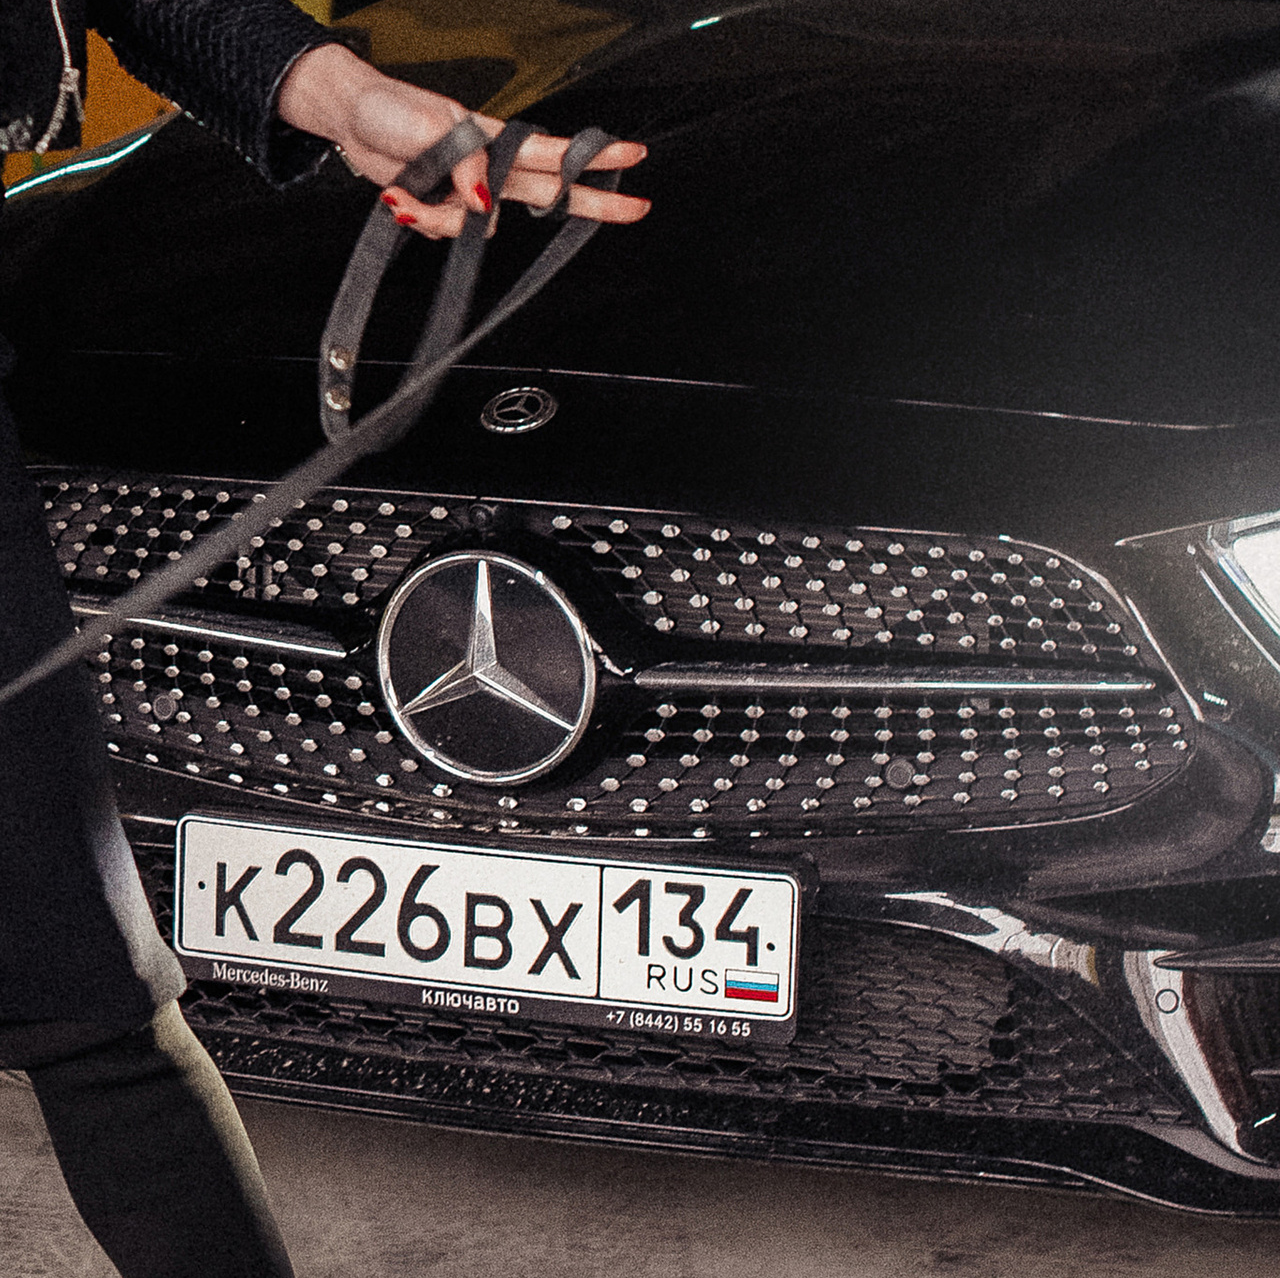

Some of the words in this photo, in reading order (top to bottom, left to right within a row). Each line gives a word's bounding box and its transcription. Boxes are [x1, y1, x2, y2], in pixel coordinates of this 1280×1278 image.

[612, 878, 760, 967] 134
[212, 961, 329, 993] Mercedes-Benz
[646, 963, 719, 995] RUS
[606, 1010, 625, 1025] +7
[629, 1010, 679, 1033] (8442)
[683, 1016, 703, 1033] 55
[709, 1018, 727, 1035] 16
[731, 1021, 751, 1037] 55
